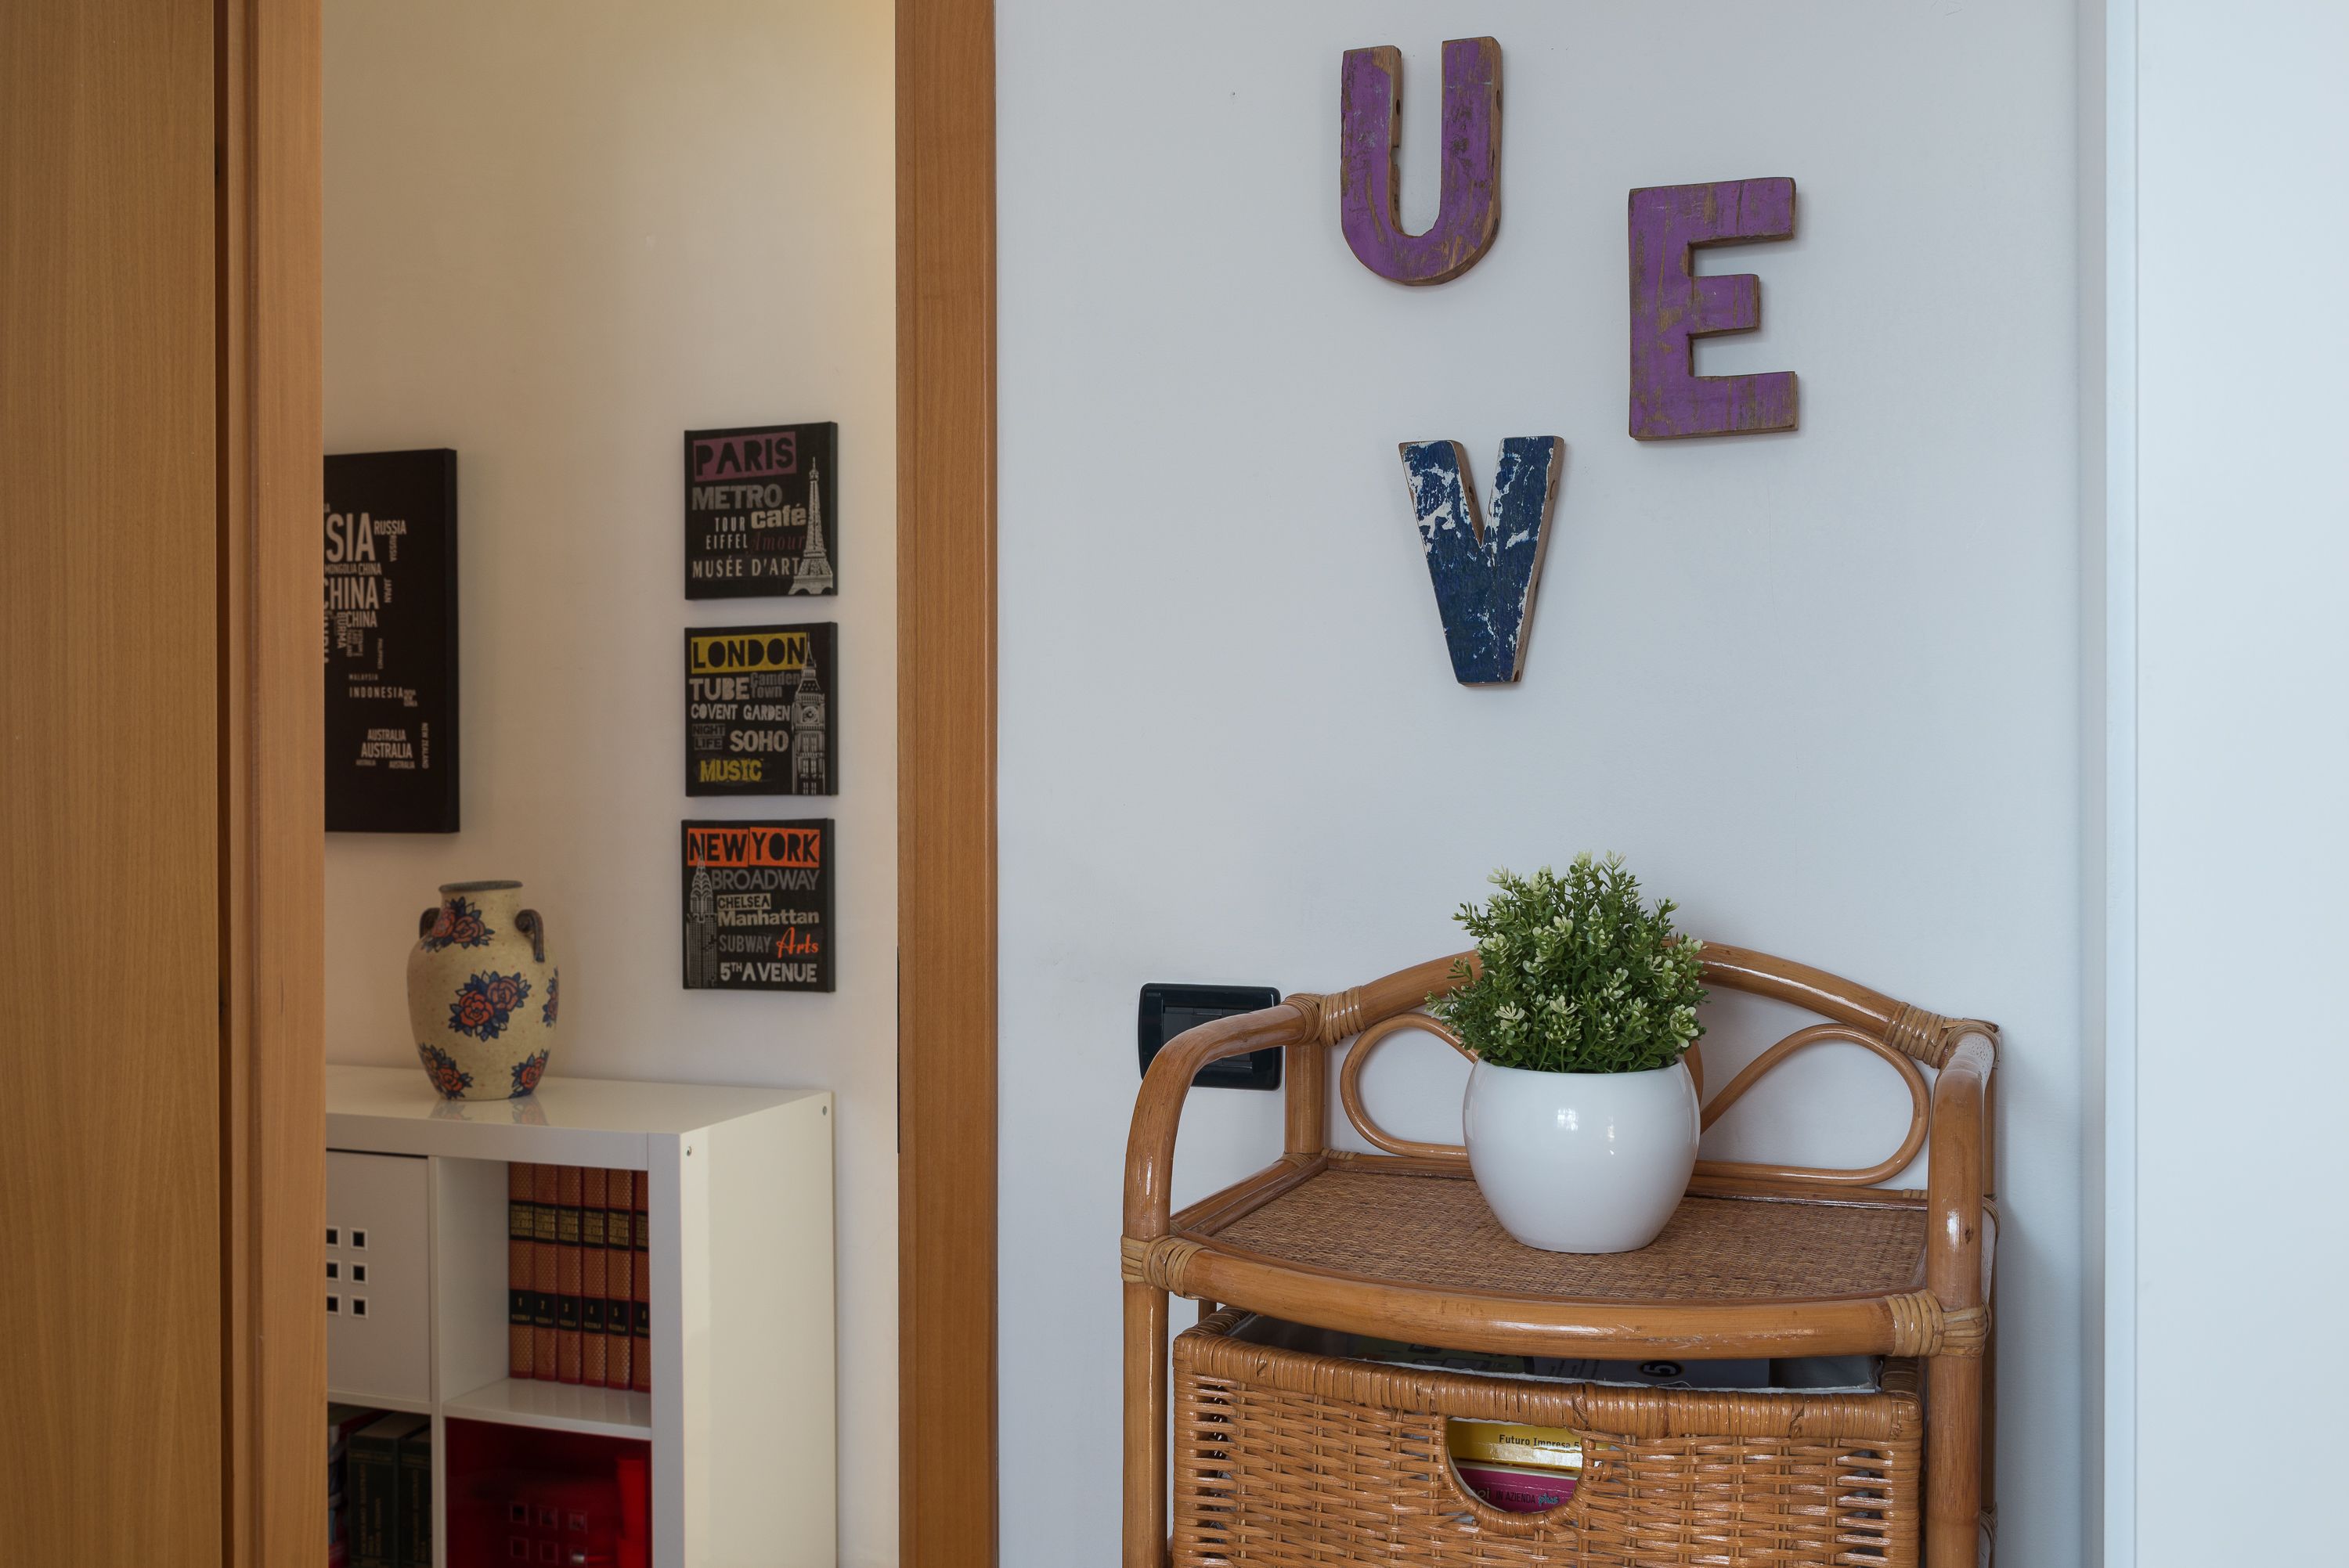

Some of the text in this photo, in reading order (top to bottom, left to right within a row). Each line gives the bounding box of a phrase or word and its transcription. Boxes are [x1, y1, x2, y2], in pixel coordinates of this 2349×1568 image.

[1341, 36, 1501, 285] U
[1629, 177, 1799, 441] E
[695, 437, 794, 477] PARIS
[692, 484, 783, 510] METRO
[715, 517, 745, 532] TOUR
[751, 503, 806, 529] café
[373, 519, 407, 535] RUSSIA
[706, 534, 748, 550] EIFFEL
[324, 564, 357, 575] MONGOLIA
[358, 562, 382, 575] CHINA
[693, 555, 801, 578] MUSÉE D'ART
[1398, 436, 1565, 686] V
[384, 579, 392, 604] JAPAN
[346, 610, 377, 629] CHINA
[337, 611, 347, 649] BURMA
[693, 637, 806, 669] LONDON
[750, 672, 801, 687] Camden
[349, 686, 403, 699] INDONESIA
[689, 676, 749, 701] TUBE
[750, 685, 782, 698] Town
[691, 704, 791, 721] COVENT GARDEN
[366, 729, 406, 741] AUSTRALIA
[693, 724, 725, 735] NIGHT
[695, 737, 722, 749] LIFE
[730, 730, 789, 752] SOHO
[361, 742, 413, 759] AUSTRALIA
[388, 760, 416, 770] AUSTRALIA
[699, 759, 763, 782] MUSIC
[689, 832, 819, 863] NEW YORK
[712, 869, 820, 891] BROADWAY
[718, 896, 770, 909] CHELSEA
[717, 909, 819, 926] Manhattan
[719, 935, 771, 953] SUBWAY
[776, 927, 819, 958] Arts
[742, 962, 817, 982] AVENUE
[1643, 1364, 1676, 1375] 5
[1499, 1434, 1530, 1446] Futuro
[1533, 1437, 1571, 1449] Impresa
[1496, 1491, 1503, 1501] IN
[1505, 1491, 1536, 1504] AZIENDA
[1538, 1492, 1560, 1506] plus
